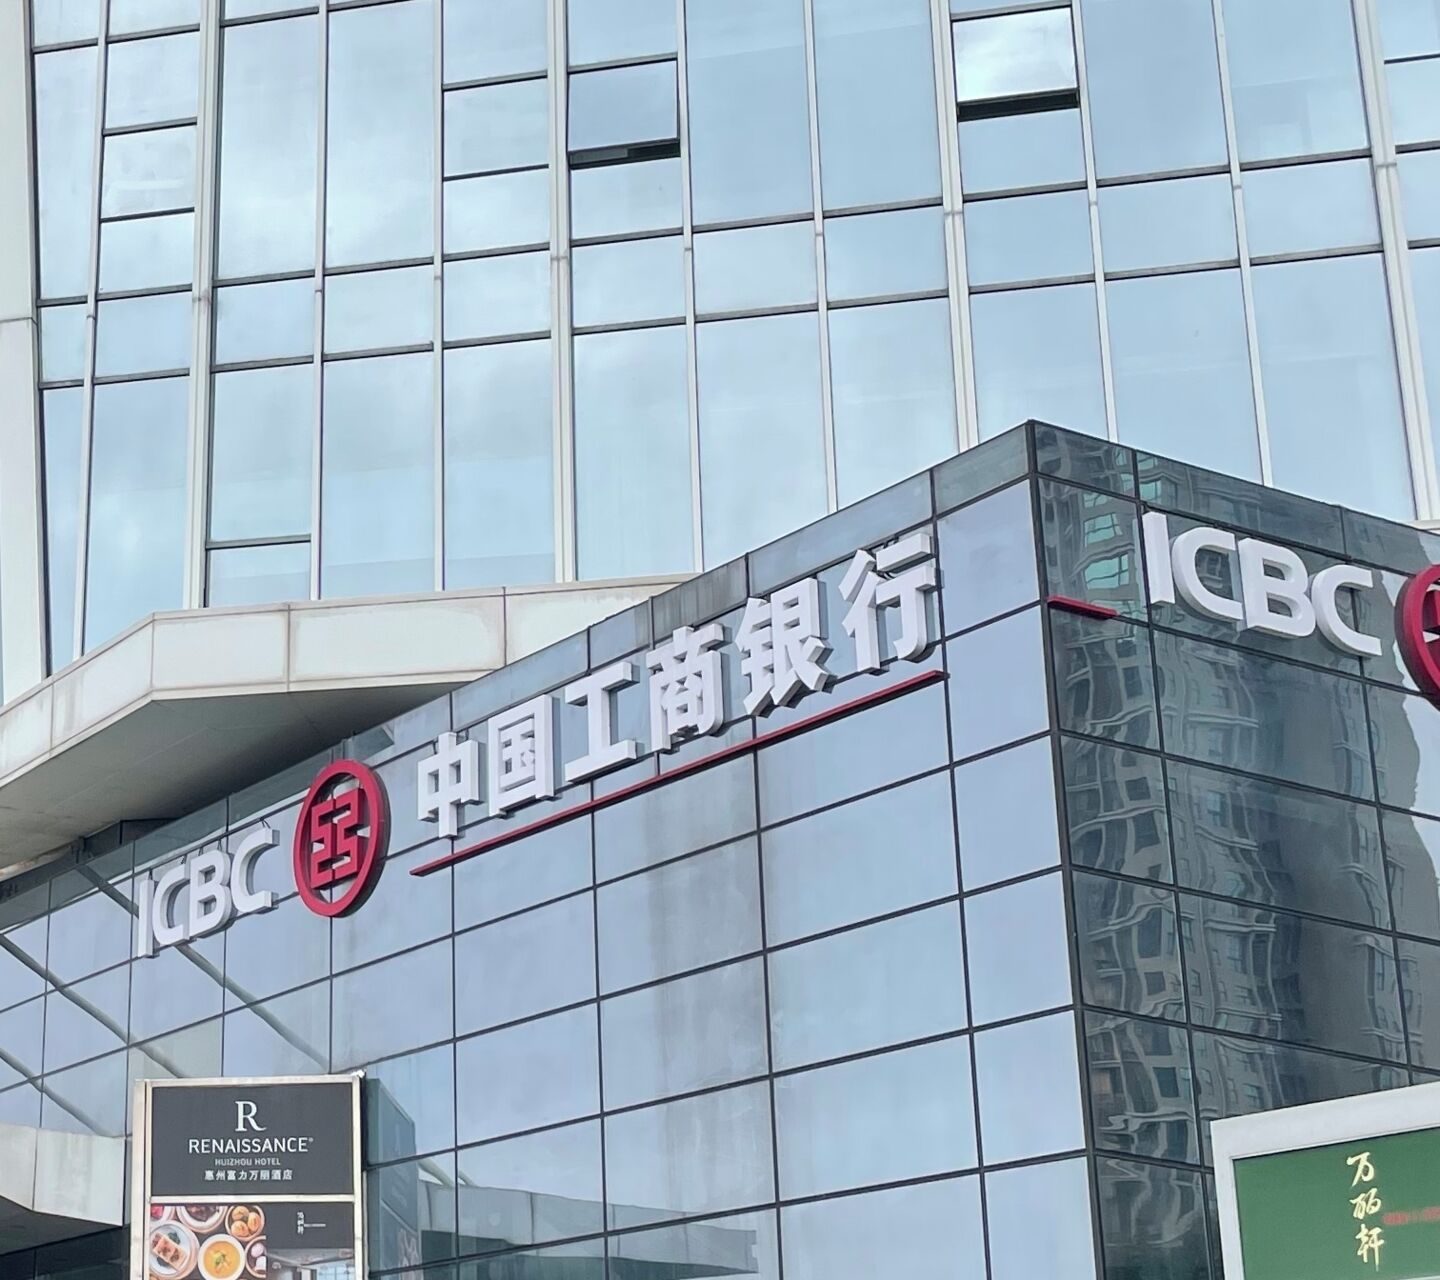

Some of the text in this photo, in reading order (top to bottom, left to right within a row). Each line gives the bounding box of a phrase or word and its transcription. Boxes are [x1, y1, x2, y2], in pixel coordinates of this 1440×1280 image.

[1142, 511, 1382, 657] ICBC
[417, 532, 938, 839] 中国工商银行
[137, 828, 280, 958] ICBC
[188, 1137, 308, 1154] RENAISSANCE
[234, 1100, 267, 1132] R
[215, 1157, 281, 1166] HUIZHOU HOTEL
